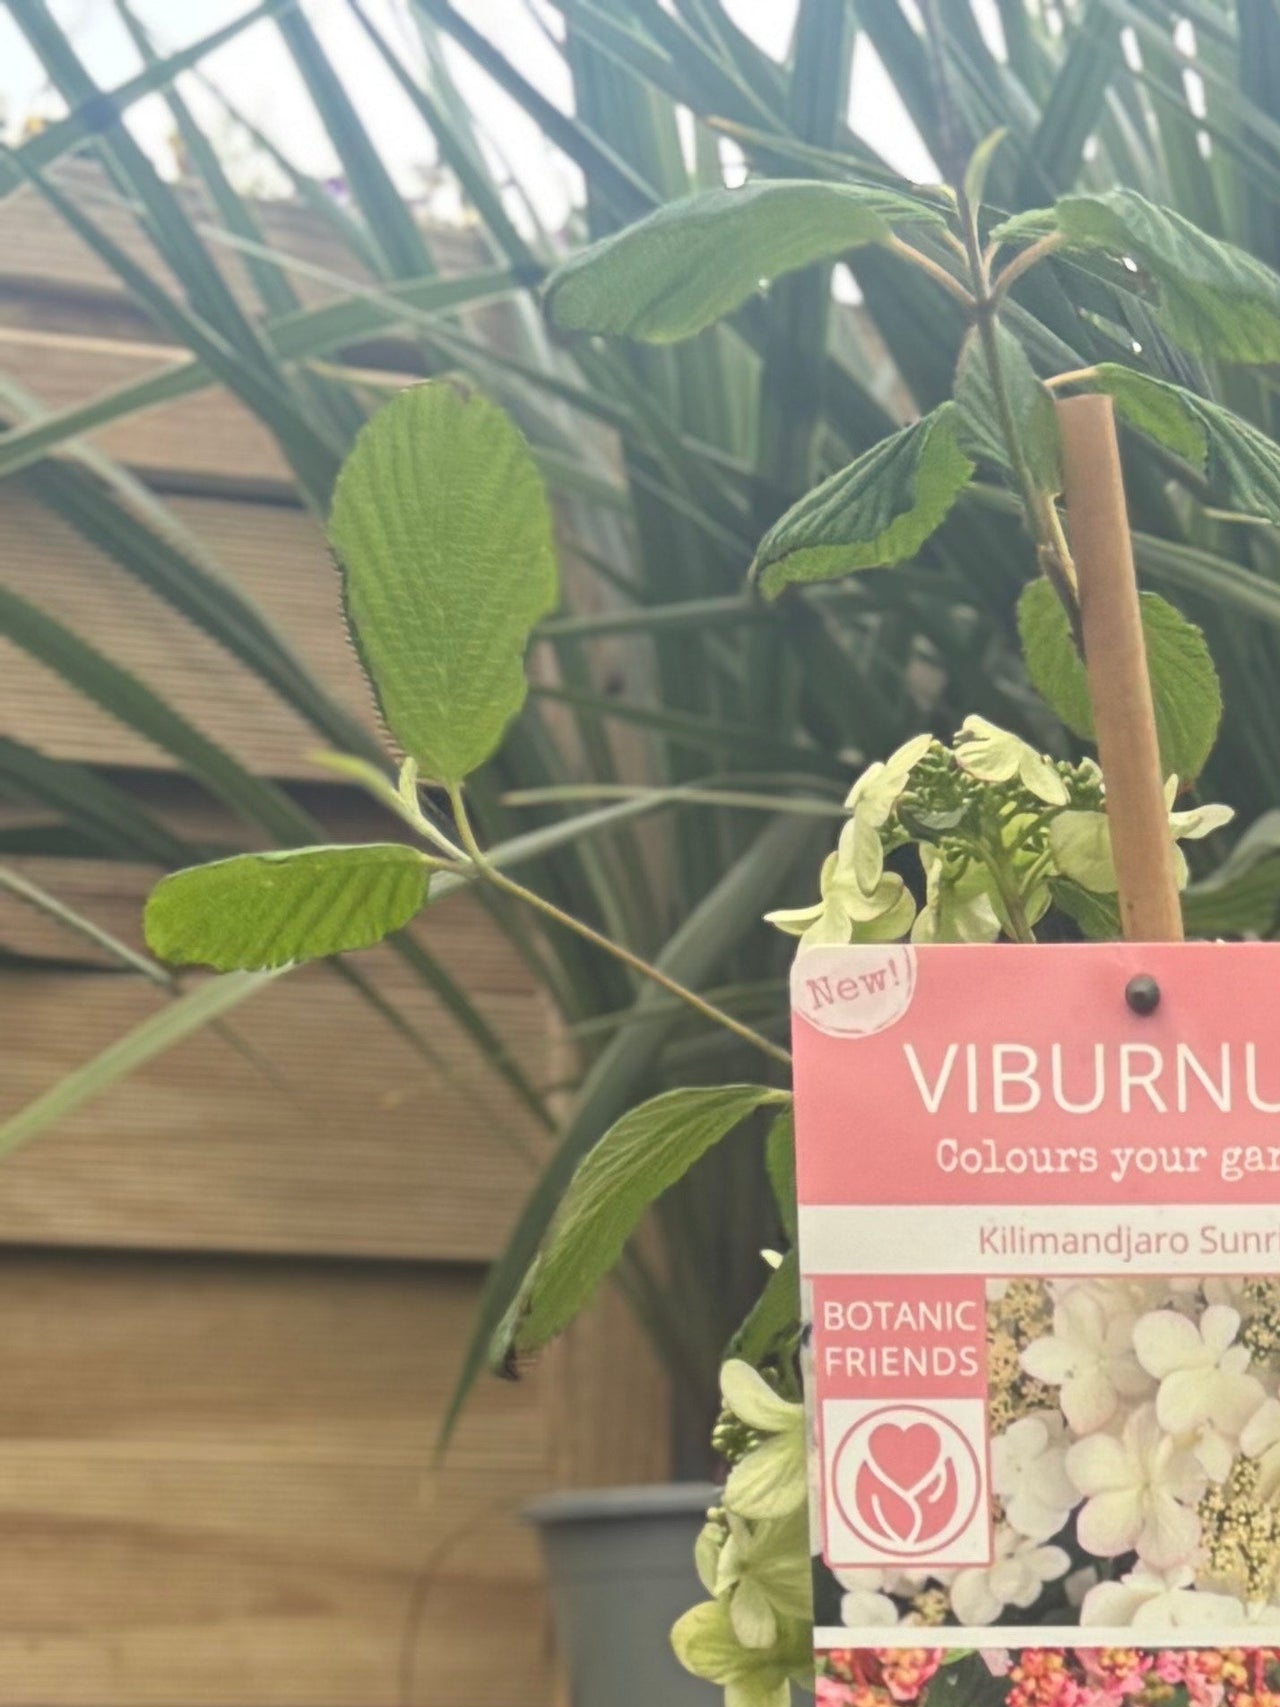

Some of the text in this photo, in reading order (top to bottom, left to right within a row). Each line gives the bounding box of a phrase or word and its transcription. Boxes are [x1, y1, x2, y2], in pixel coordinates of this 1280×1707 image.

[805, 958, 901, 1011] New!
[936, 1138, 1099, 1174] Colours
[1111, 1145, 1208, 1183] your
[978, 1225, 1189, 1263] Kilimandjaro
[823, 1301, 977, 1332] BOTANIC
[824, 1346, 979, 1378] FRIENDS
